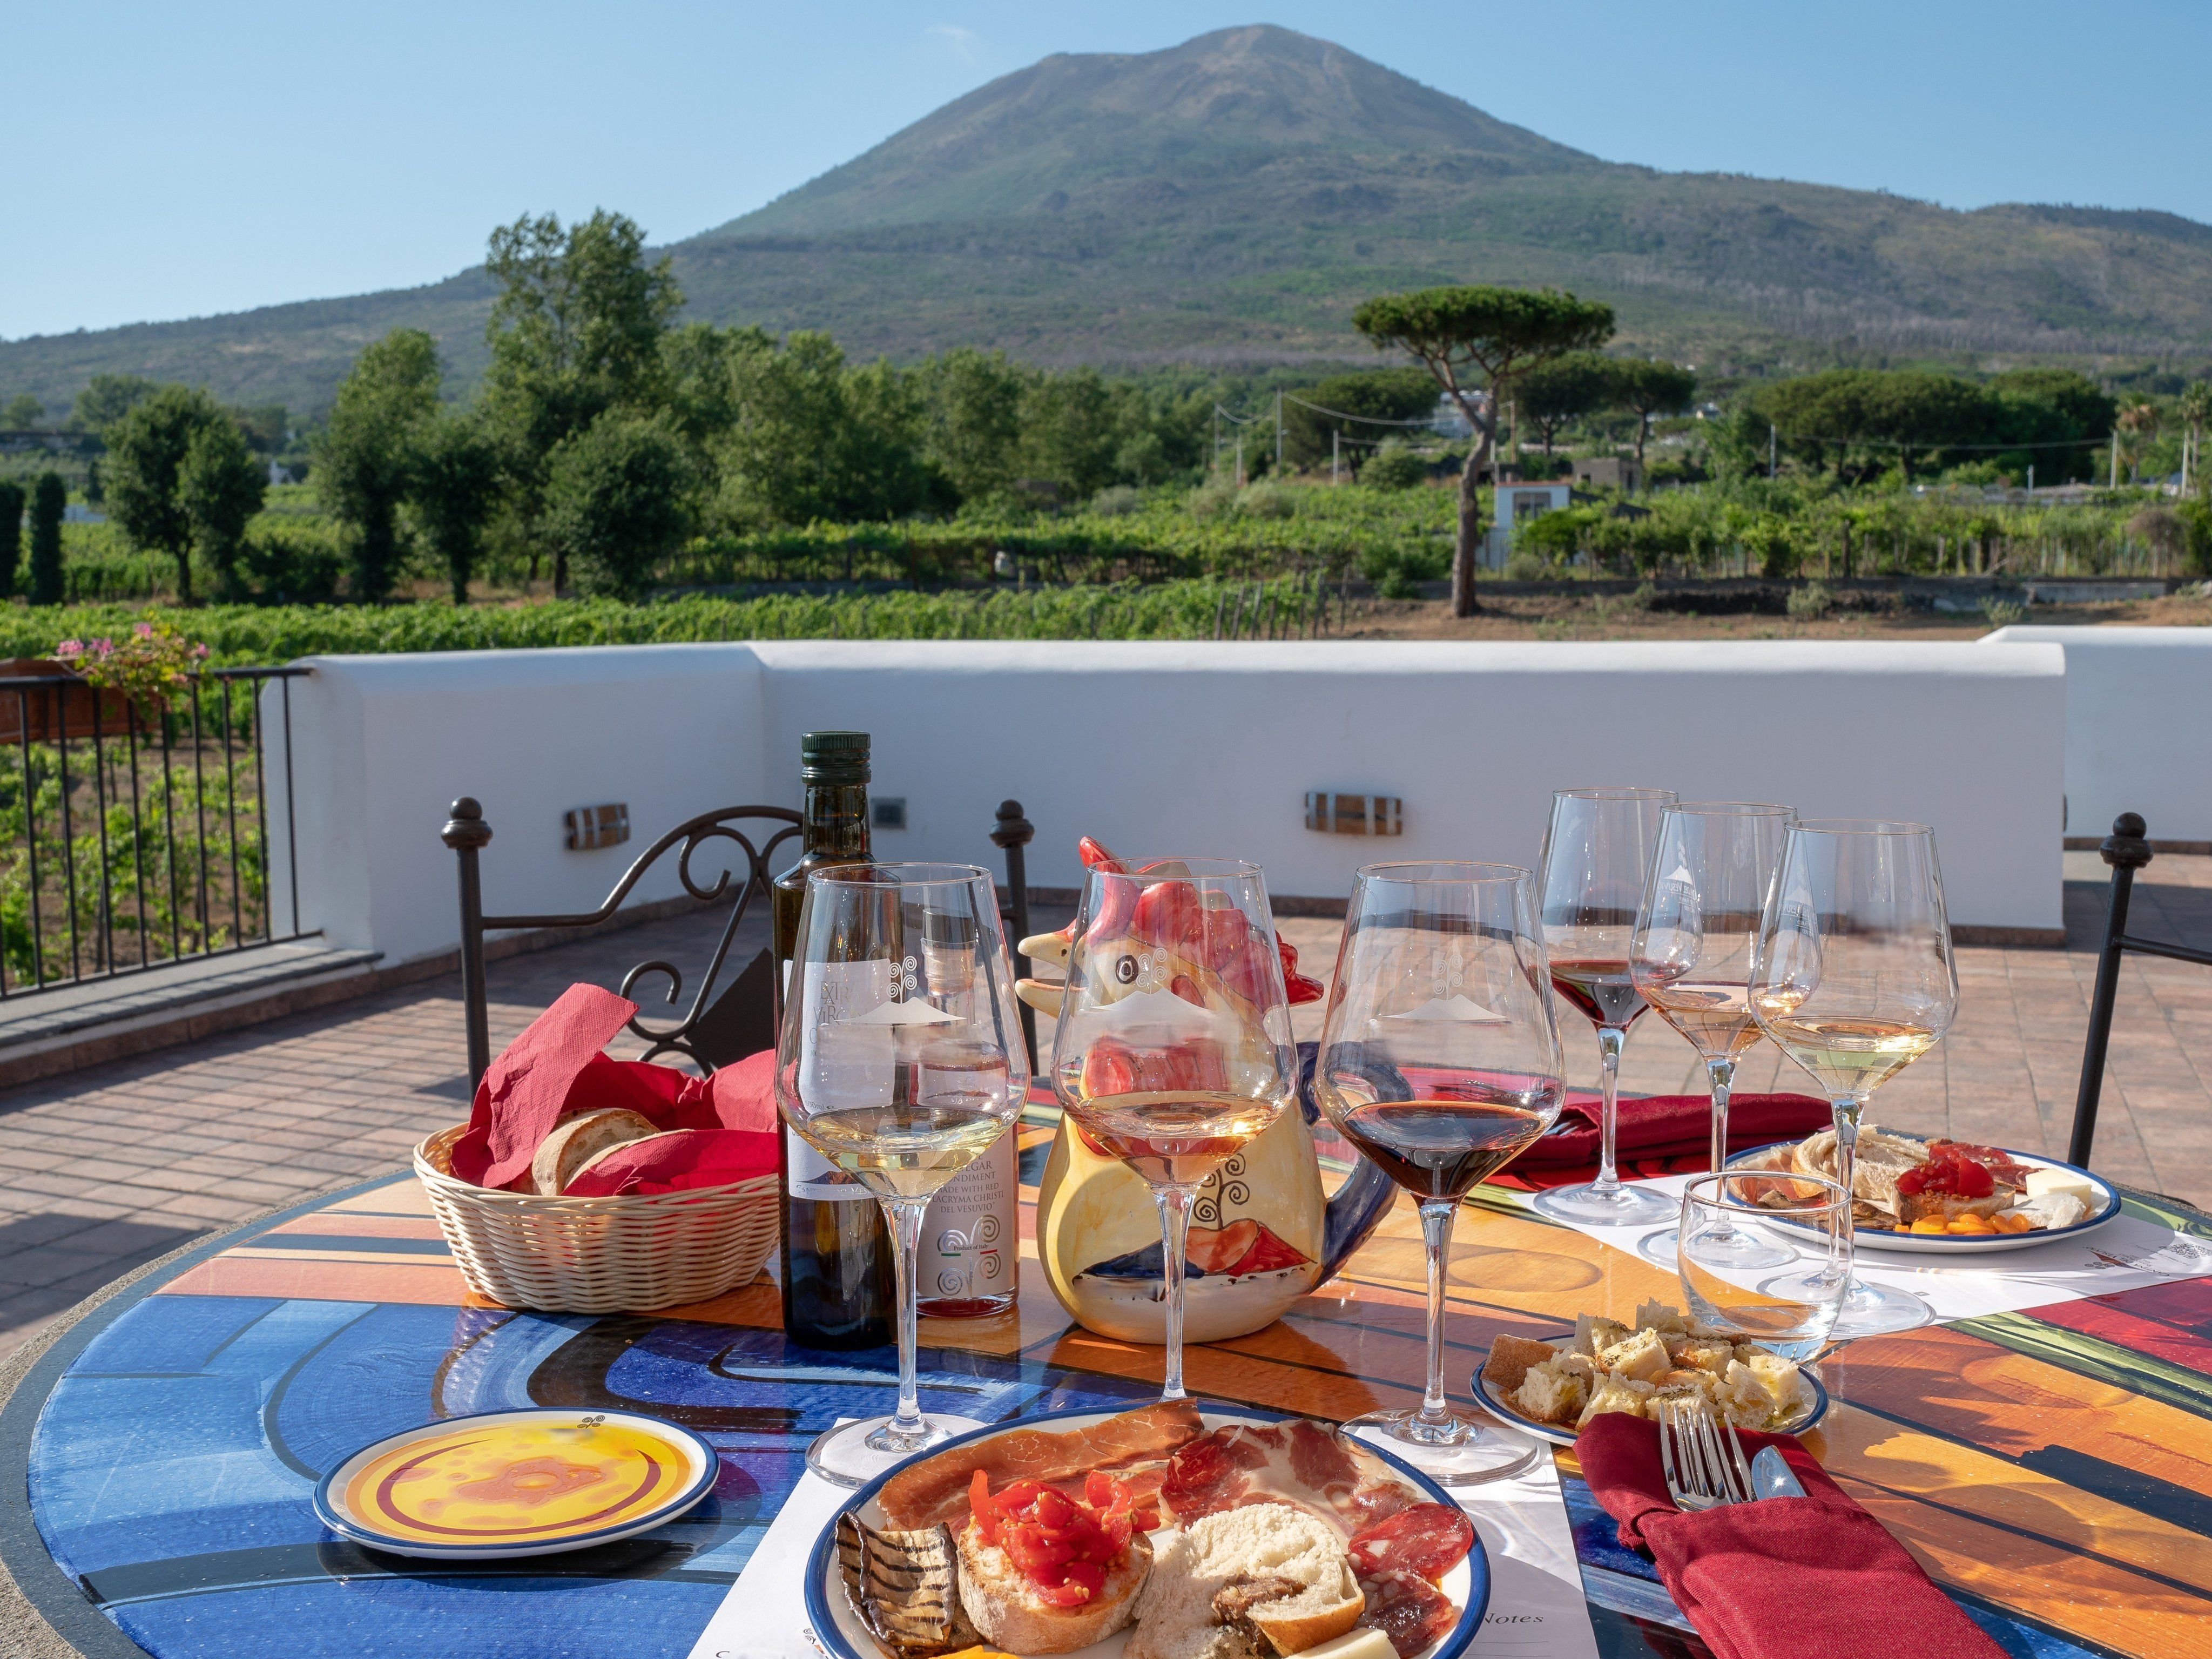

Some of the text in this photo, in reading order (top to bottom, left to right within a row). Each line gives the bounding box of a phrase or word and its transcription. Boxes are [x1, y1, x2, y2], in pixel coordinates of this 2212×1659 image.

[986, 1182, 999, 1191] RED
[932, 1190, 1004, 1203] LACRYMA CHRISTI
